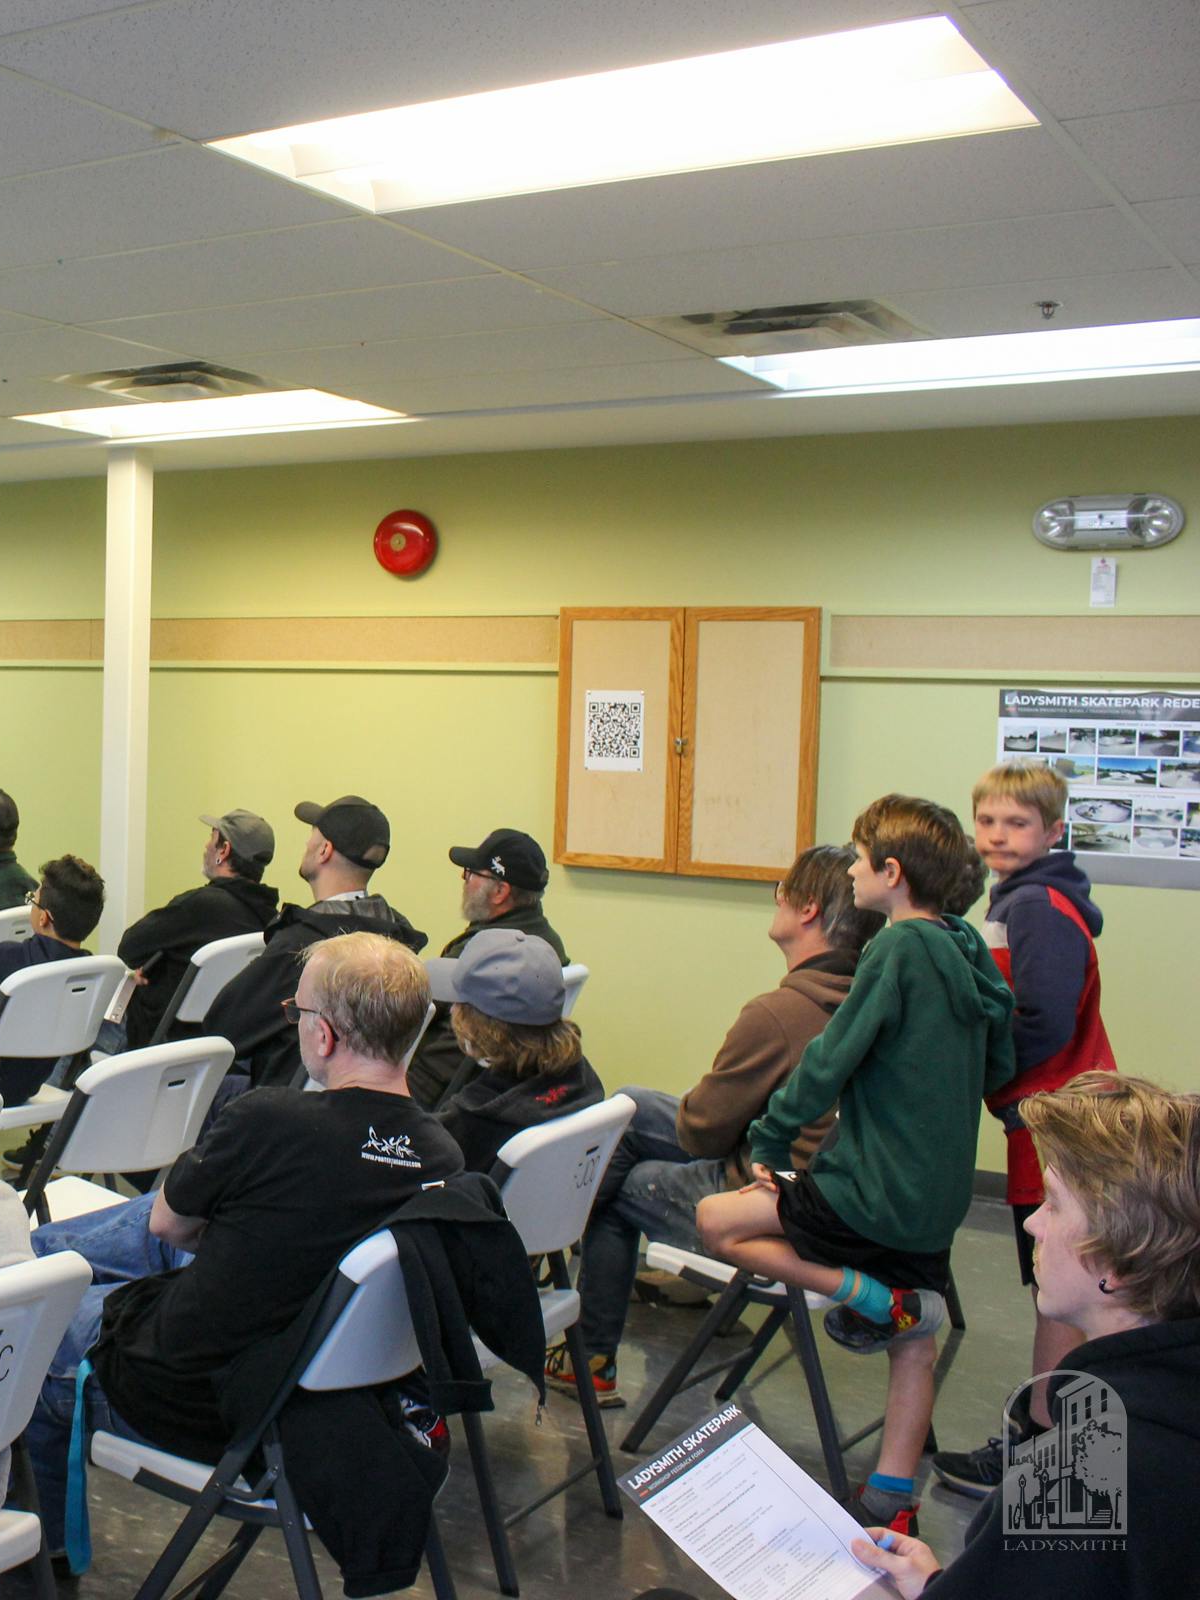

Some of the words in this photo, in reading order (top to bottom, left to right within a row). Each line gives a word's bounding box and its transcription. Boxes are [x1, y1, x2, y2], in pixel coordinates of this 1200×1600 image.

[1004, 695, 1078, 707] LADYSMITH
[1081, 696, 1160, 708] SKATEPARK
[1163, 697, 1200, 709] REDE
[627, 1445, 686, 1490] LADYSMITH
[682, 1404, 742, 1451] SKATEPARK
